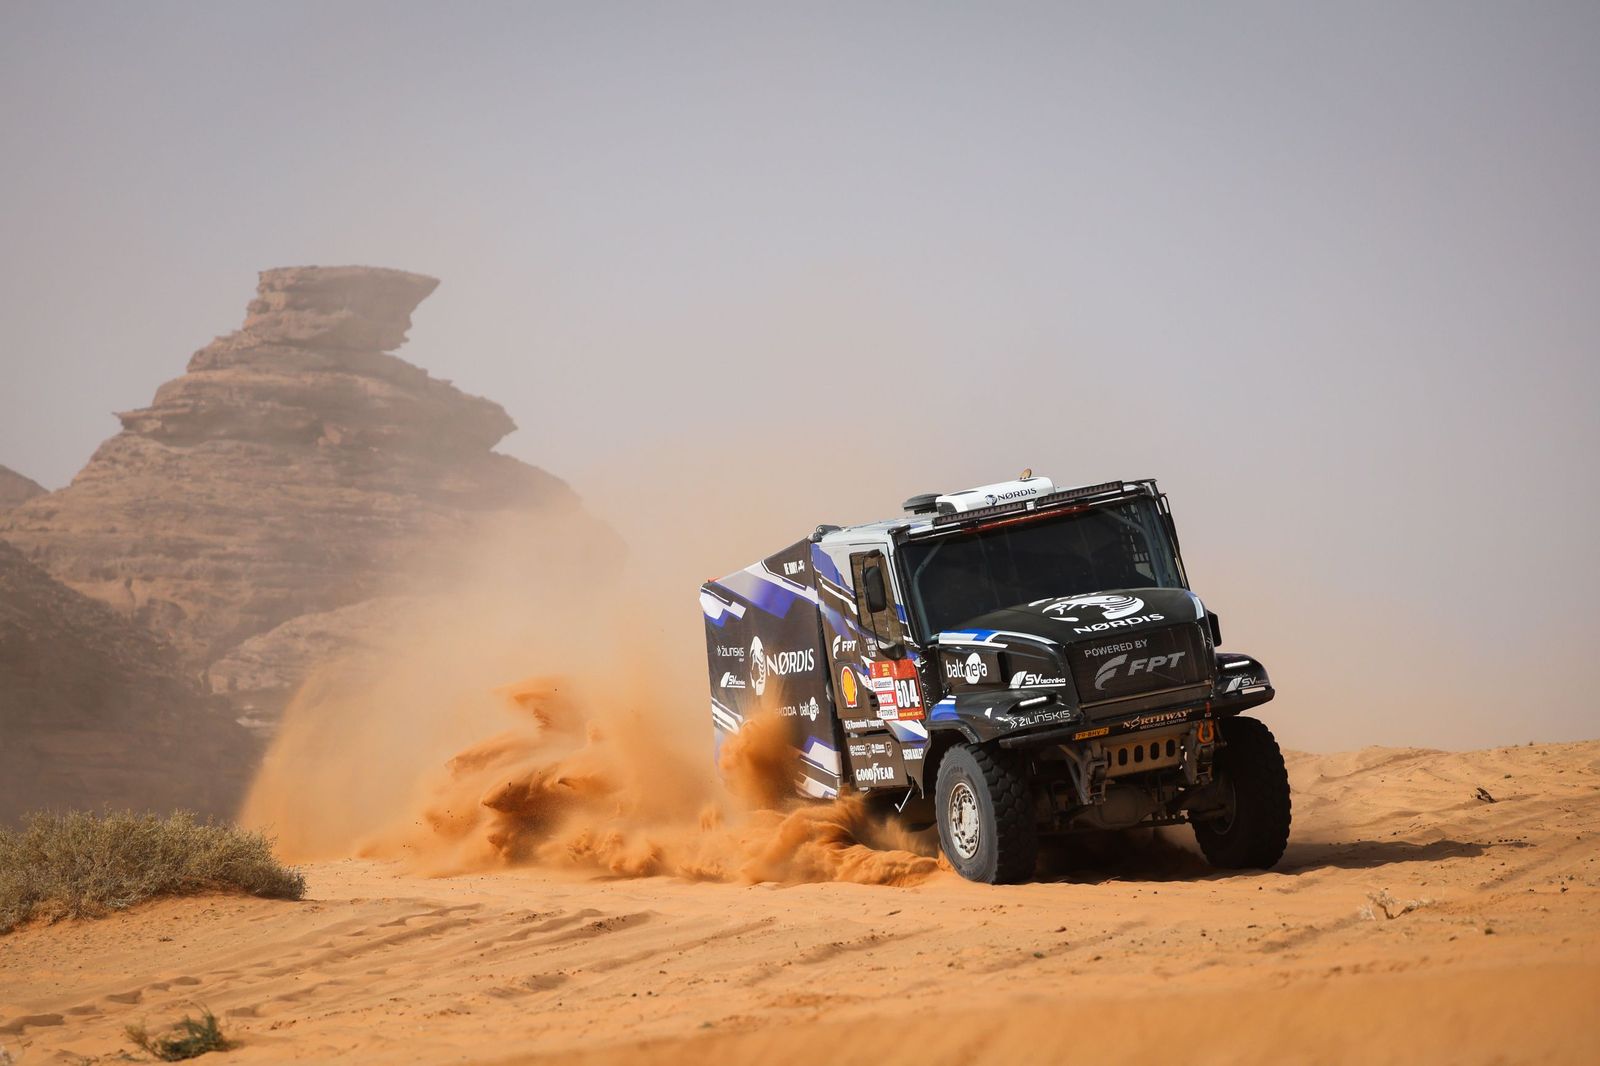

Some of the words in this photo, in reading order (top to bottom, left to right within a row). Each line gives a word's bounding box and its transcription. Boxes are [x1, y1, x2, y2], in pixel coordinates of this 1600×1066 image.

[841, 640, 857, 652] FPT
[1084, 642, 1133, 658] POWERED
[1135, 639, 1148, 649] BY
[1127, 651, 1186, 676] FPT
[894, 679, 921, 708] 604
[856, 765, 894, 782] GOODYEAR
